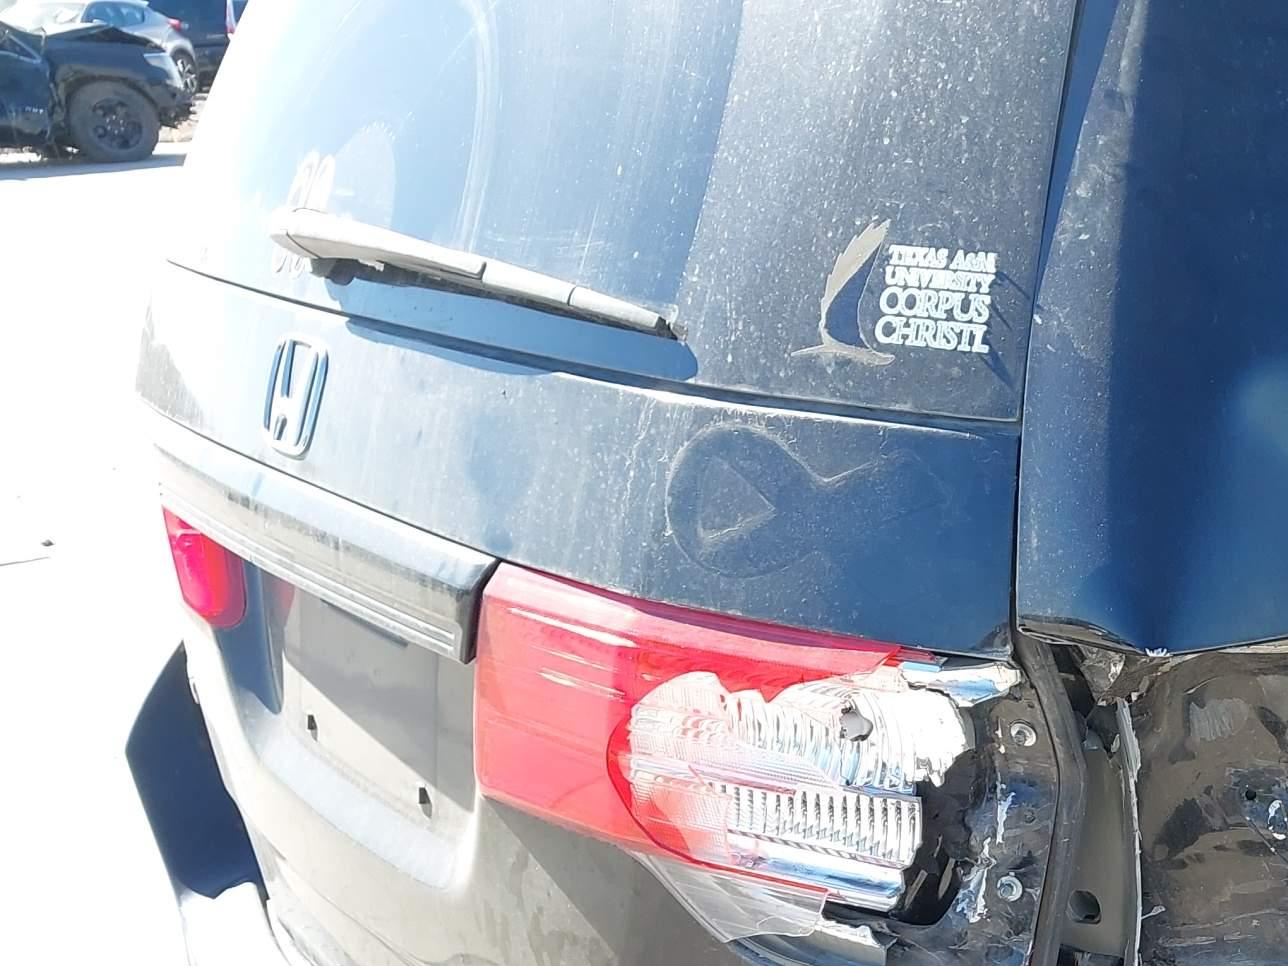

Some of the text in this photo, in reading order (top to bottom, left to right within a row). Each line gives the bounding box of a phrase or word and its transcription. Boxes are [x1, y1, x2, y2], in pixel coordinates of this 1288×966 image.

[888, 244, 949, 269] TEXAS
[885, 265, 996, 293] UNIVERSITY
[879, 286, 992, 323] CORPUS
[874, 315, 990, 353] CHRISTI
